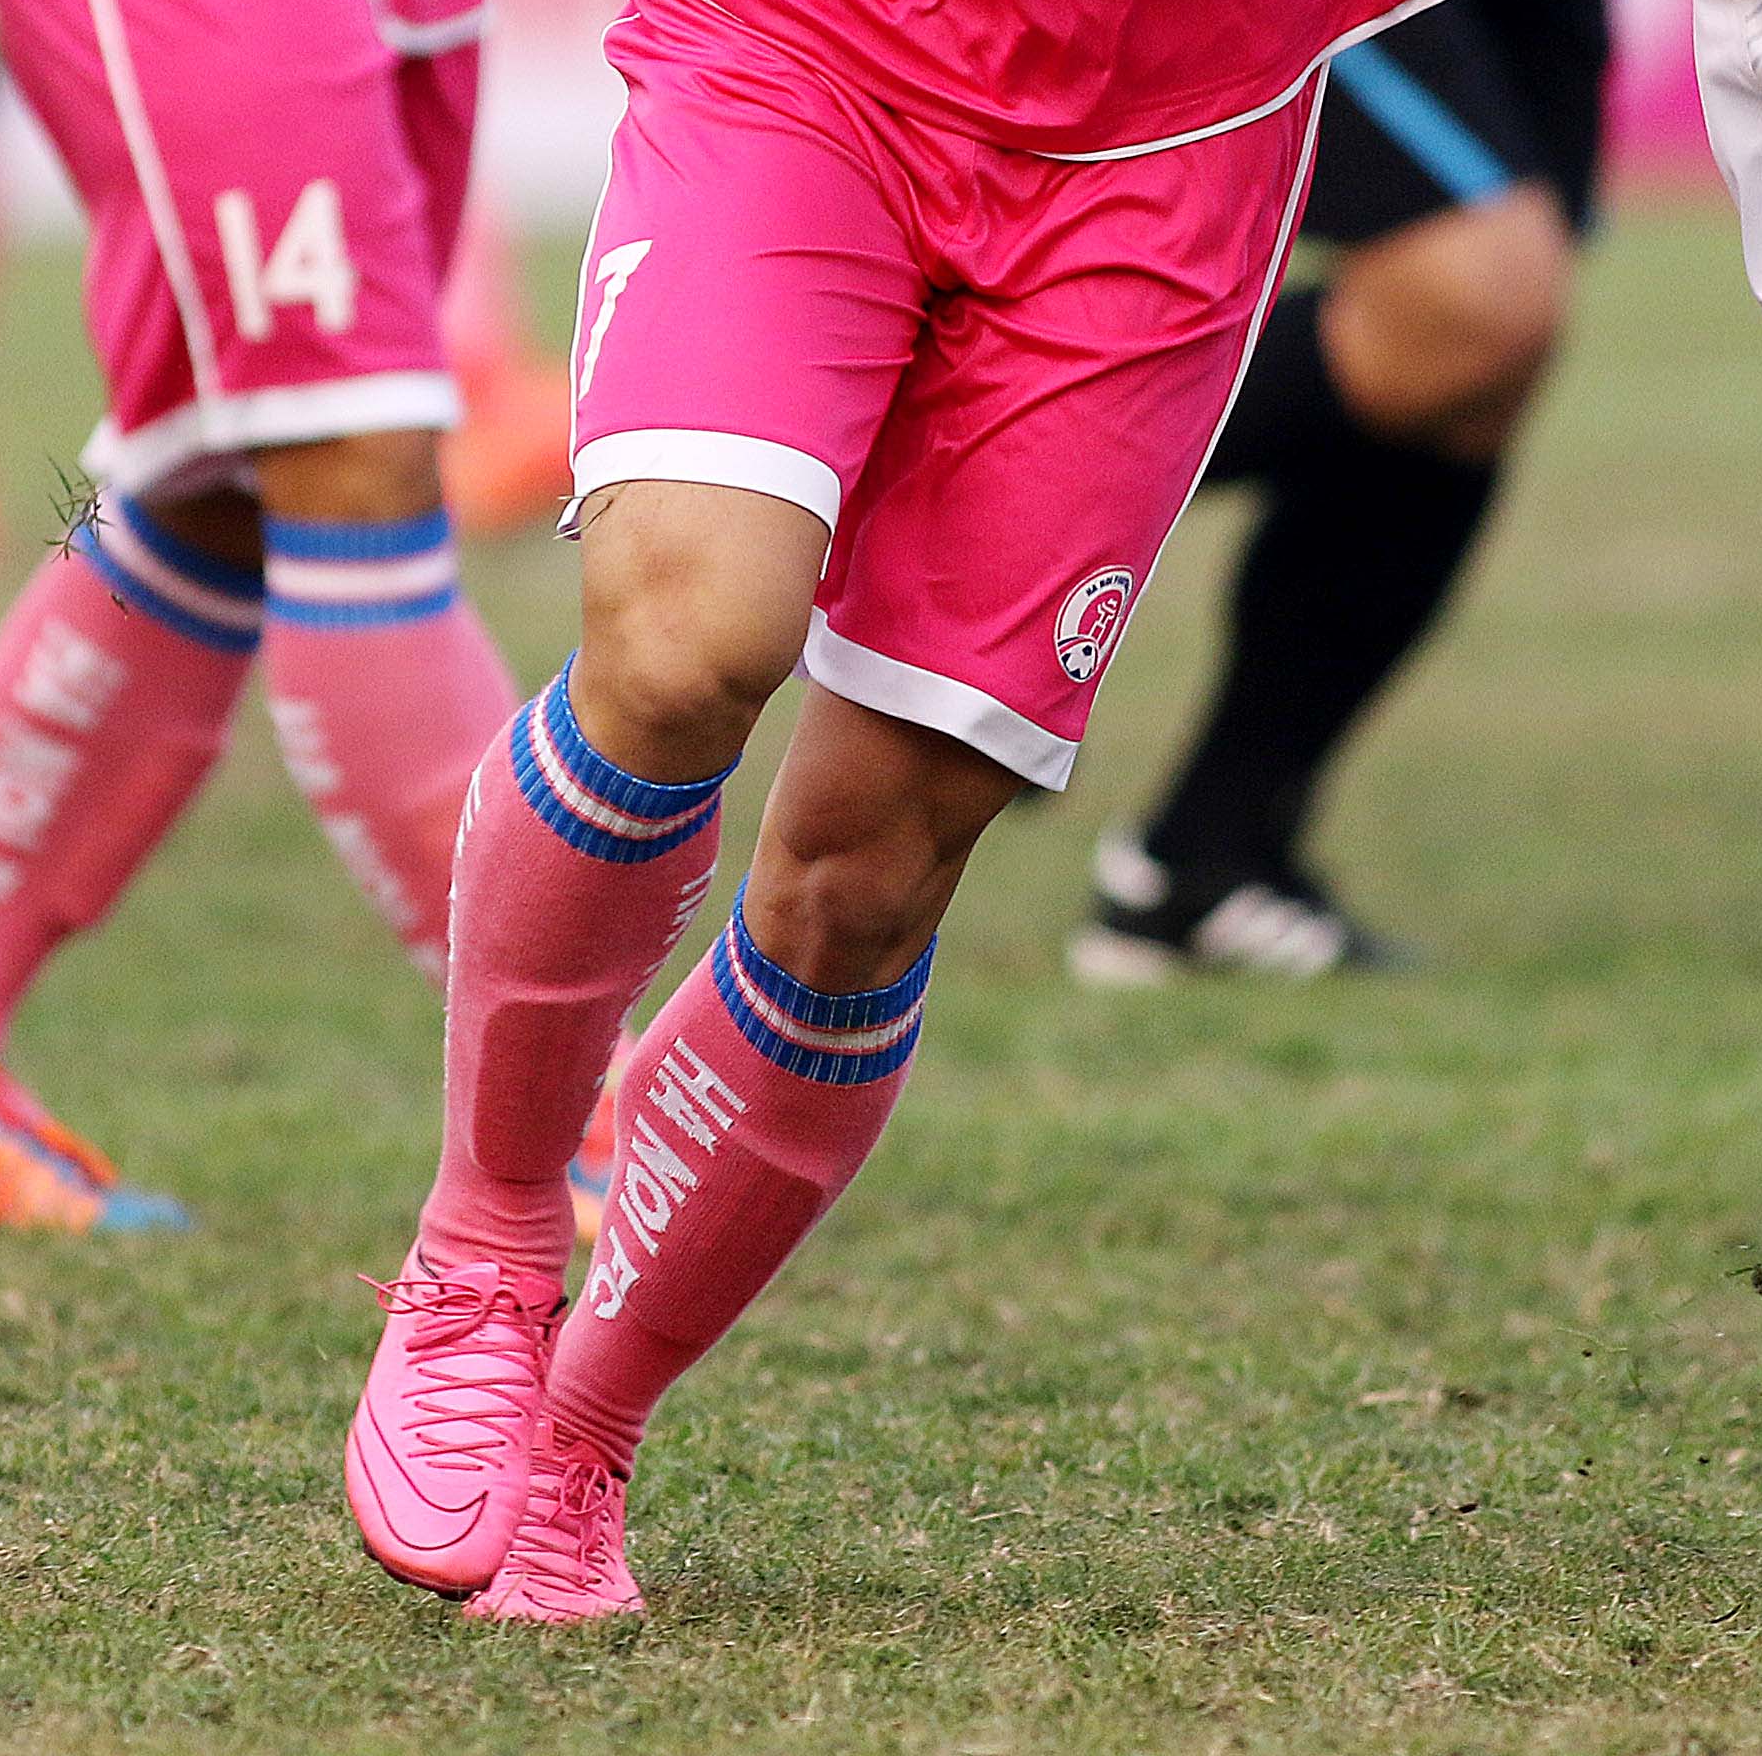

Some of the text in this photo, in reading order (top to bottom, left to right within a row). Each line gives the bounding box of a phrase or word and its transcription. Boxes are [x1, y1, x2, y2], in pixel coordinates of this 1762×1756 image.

[213, 177, 357, 342] 14
[646, 1036, 747, 1155] HA
[618, 1113, 699, 1258] NOI
[588, 1225, 641, 1321] FC
